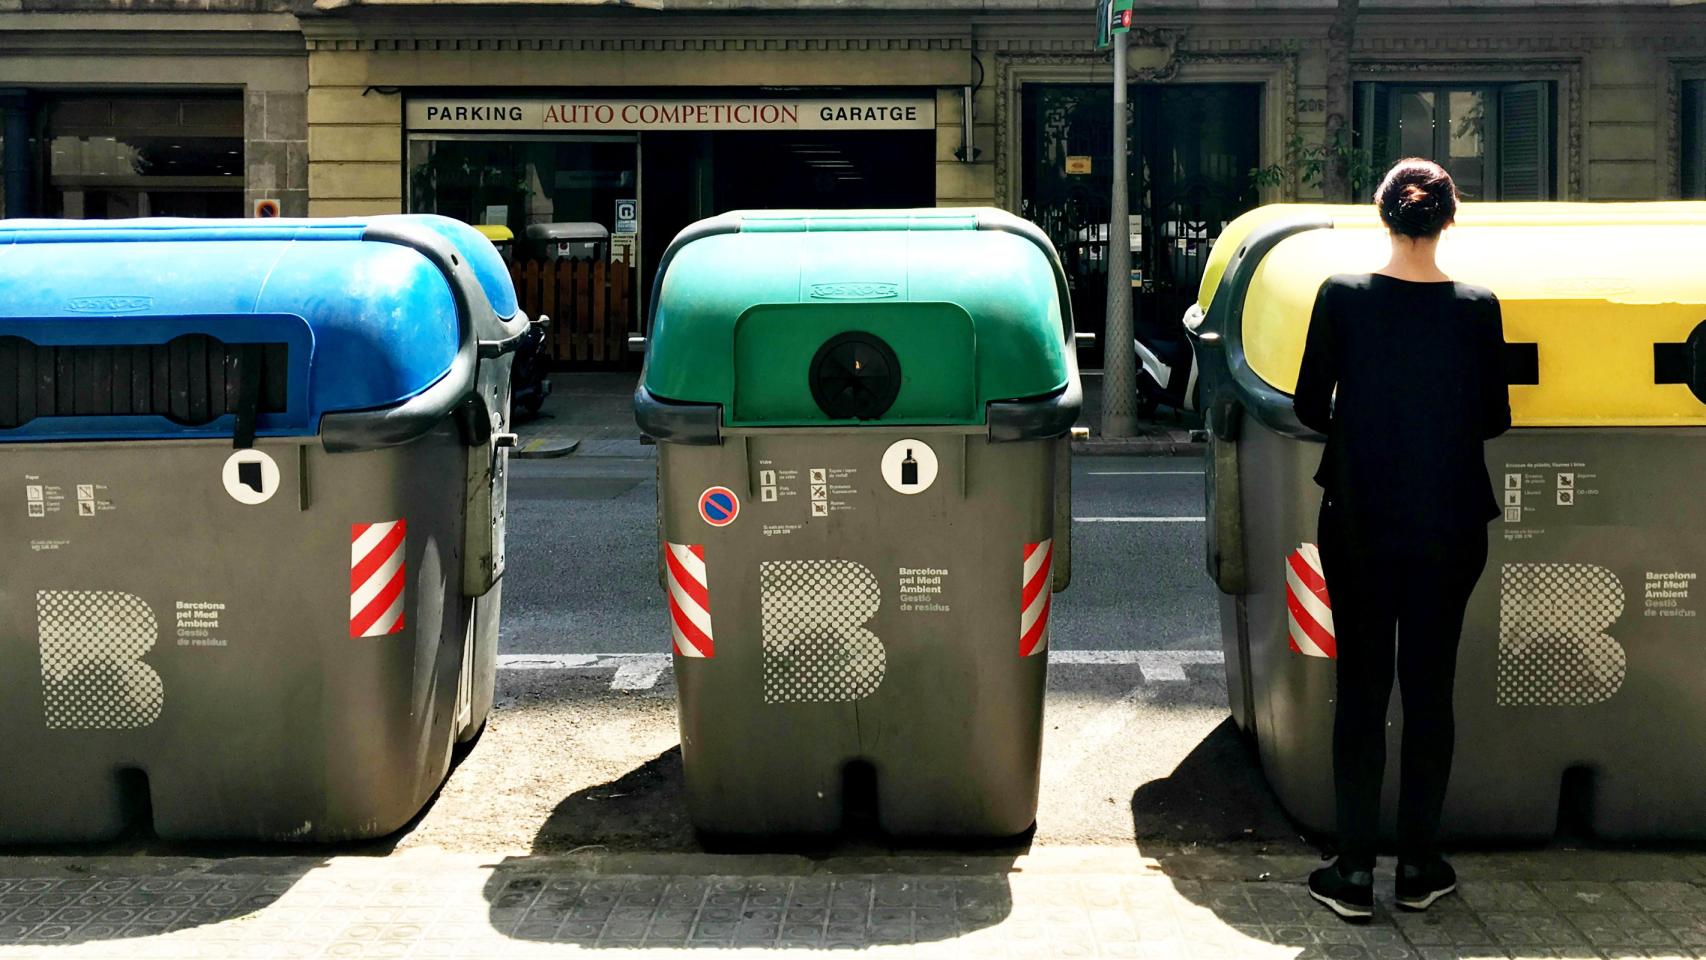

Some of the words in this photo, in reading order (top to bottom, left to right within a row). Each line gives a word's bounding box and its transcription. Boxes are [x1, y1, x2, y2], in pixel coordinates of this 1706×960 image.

[427, 106, 523, 121] PARKING
[544, 104, 614, 123] AUTO
[621, 104, 799, 123] COMPETICION
[820, 106, 917, 121] GARATGE
[899, 567, 949, 575] Barcelona
[1646, 571, 1697, 580] Barcelona
[900, 576, 915, 586] pel
[917, 576, 941, 584] Medi
[1645, 580, 1661, 590] pel
[1663, 580, 1688, 588] Medi
[900, 585, 942, 593] Ambient
[1645, 590, 1688, 598] Ambient
[176, 601, 226, 610] Barcelona
[900, 603, 913, 611] de
[915, 603, 950, 611] residus
[176, 610, 192, 620] pel
[194, 610, 218, 618] Medi
[1643, 608, 1658, 616] de
[1659, 608, 1696, 616] residus
[177, 619, 219, 628] Ambient
[177, 638, 190, 646] de
[192, 637, 228, 646] residus
